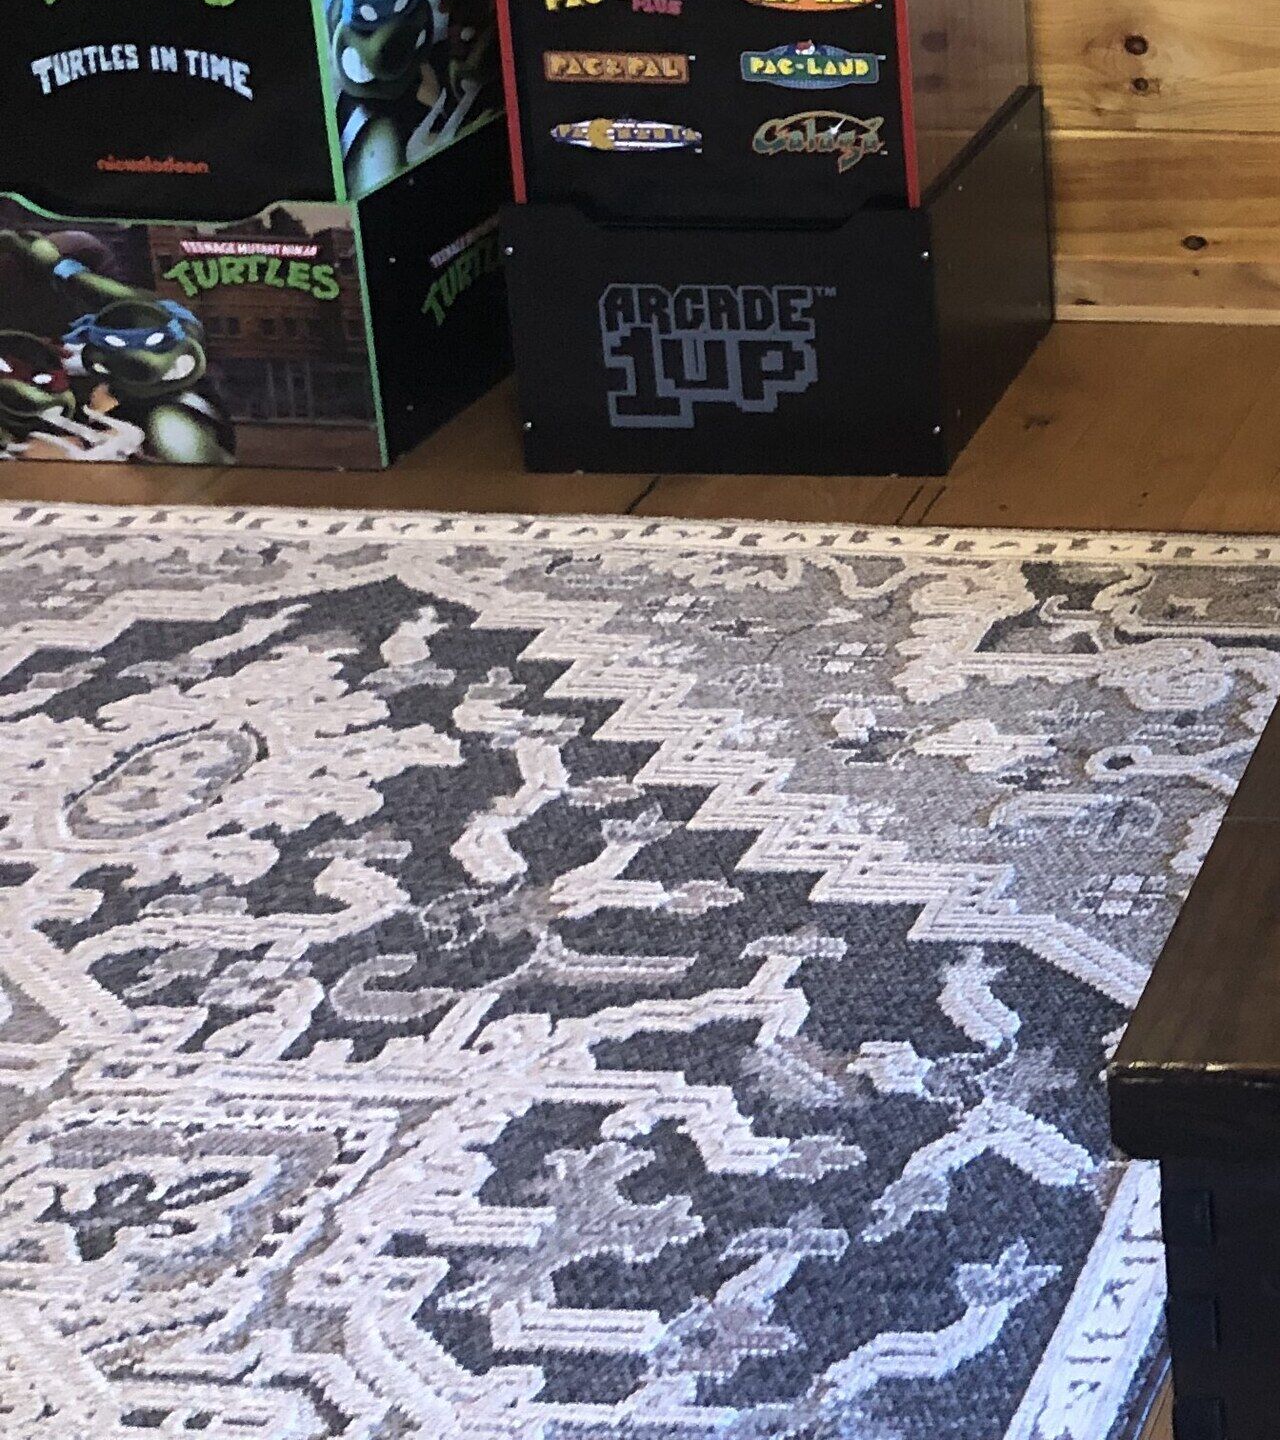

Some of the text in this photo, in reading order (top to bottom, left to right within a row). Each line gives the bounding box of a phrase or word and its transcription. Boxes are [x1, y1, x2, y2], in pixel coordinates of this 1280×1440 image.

[31, 43, 254, 101] TURTLES IN TIME
[749, 56, 870, 76] PAC-LAND
[163, 253, 341, 301] TURTLES
[600, 283, 815, 334] ARCADE
[605, 326, 818, 428] 1UP
